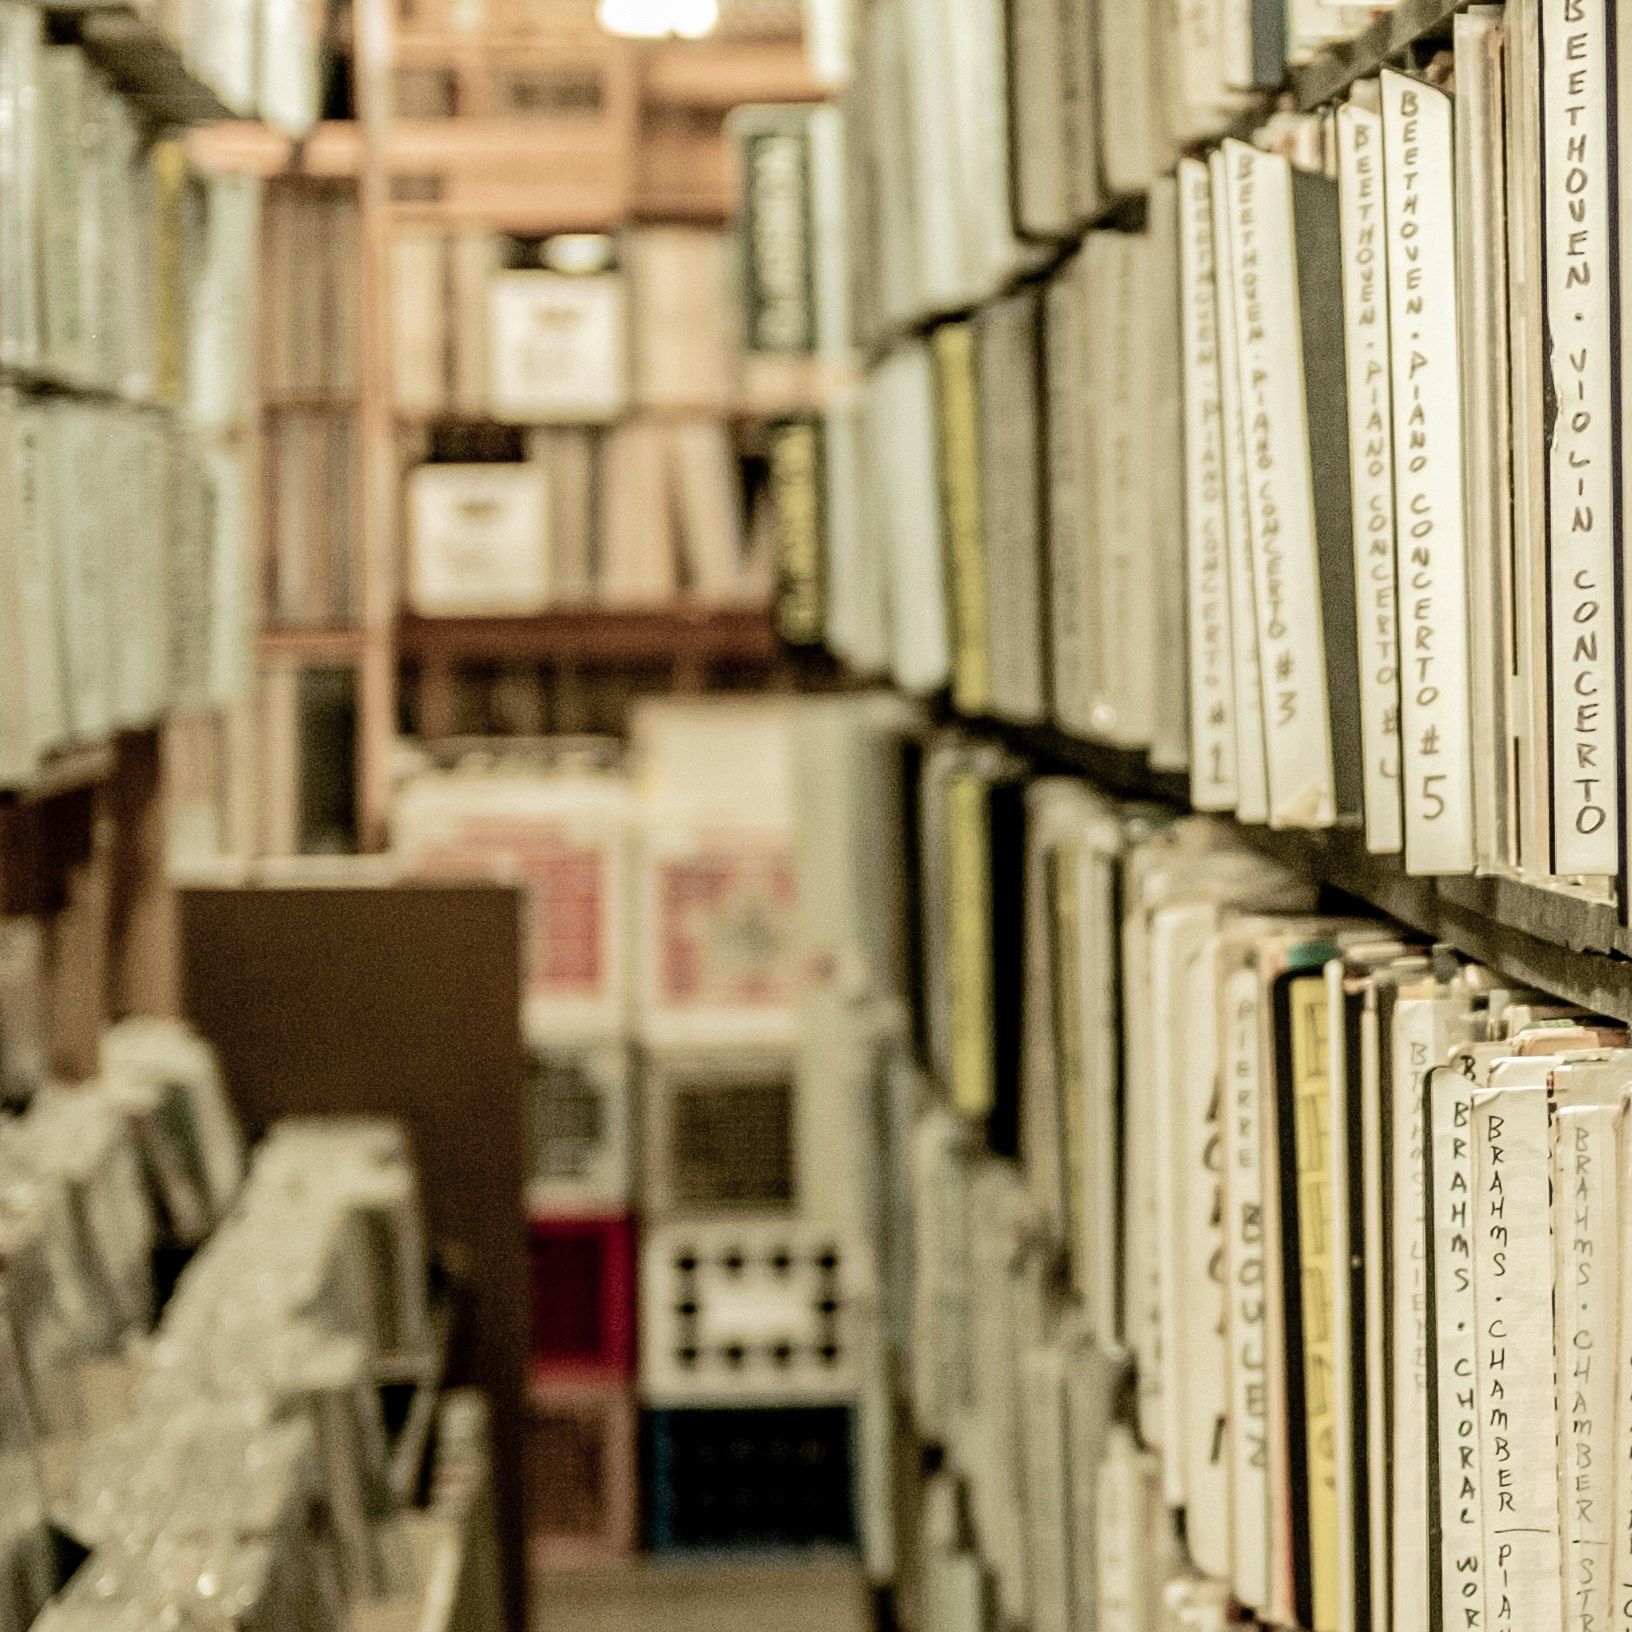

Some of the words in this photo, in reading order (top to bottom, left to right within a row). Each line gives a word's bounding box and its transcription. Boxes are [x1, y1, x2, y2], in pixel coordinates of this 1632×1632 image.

[1236, 152, 1265, 346] BEETHOVEN
[1354, 122, 1377, 327] BEETHOVEN
[1399, 88, 1425, 317] BEETHOVEN
[1250, 367, 1275, 472] PIANO
[1364, 357, 1386, 478] PIANO
[1407, 349, 1430, 475] PIANO
[1569, 347, 1595, 534] VIOLIN
[1257, 479, 1286, 641] CONCERTO
[1368, 492, 1396, 687] CONCERTO
[1409, 493, 1440, 708] CONCERTO
[1571, 569, 1607, 835] CONCERTO
[1233, 998, 1255, 1170] PIERRE
[1452, 1099, 1472, 1292] BRAHMS
[1486, 1114, 1509, 1278] BRAHMS
[1573, 1126, 1594, 1288] BRAHMS
[1454, 1356, 1478, 1525] CHORAL
[1487, 1316, 1518, 1515] CHAMBER
[1571, 1327, 1596, 1526] CHAMBER
